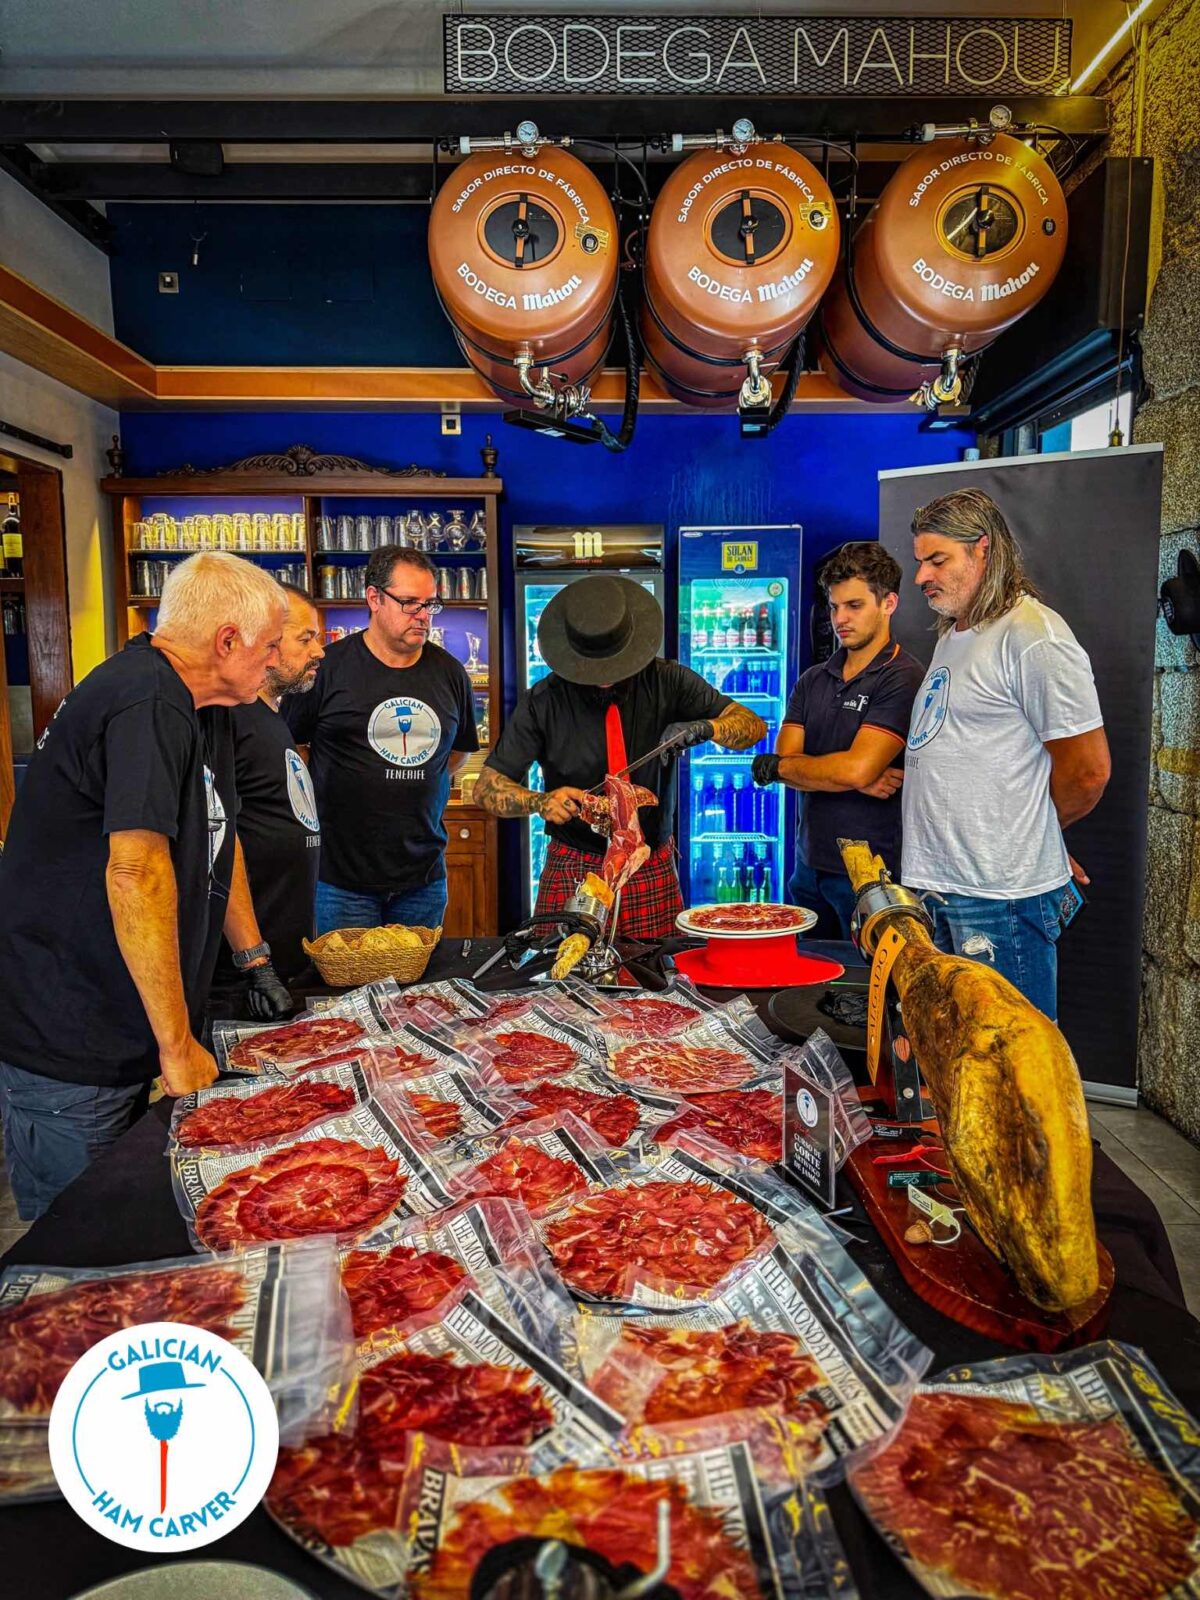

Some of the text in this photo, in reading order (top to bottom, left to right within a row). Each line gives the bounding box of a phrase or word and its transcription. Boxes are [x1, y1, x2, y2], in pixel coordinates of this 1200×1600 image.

[457, 24, 1060, 86] BODEGA MAHOU
[451, 177, 483, 213] SABOR
[483, 165, 536, 182] DIRECTO
[538, 168, 556, 183] DE
[677, 182, 704, 223] SABOR
[703, 158, 753, 184] DIRECTO
[756, 159, 773, 169] DE
[909, 169, 941, 208] SABOR
[939, 151, 993, 172] DIRECTO
[995, 153, 1012, 166] DE
[456, 262, 583, 311] BODEGA Mahou
[687, 258, 815, 303] BODEGA Mahou
[912, 258, 1040, 302] BODEGA Mahou
[384, 698, 424, 711] GALICIAN
[379, 747, 430, 765] HAM CARVER
[385, 768, 426, 780] TENERIFE
[660, 1157, 690, 1177] THE
[794, 1141, 821, 1170] CORTE
[452, 1213, 477, 1244] THE
[741, 1276, 765, 1309] the
[759, 1257, 789, 1297] THE
[783, 1292, 840, 1361] MONDAY
[427, 1326, 449, 1350] the
[446, 1305, 478, 1339] THE
[705, 1452, 736, 1499] THE
